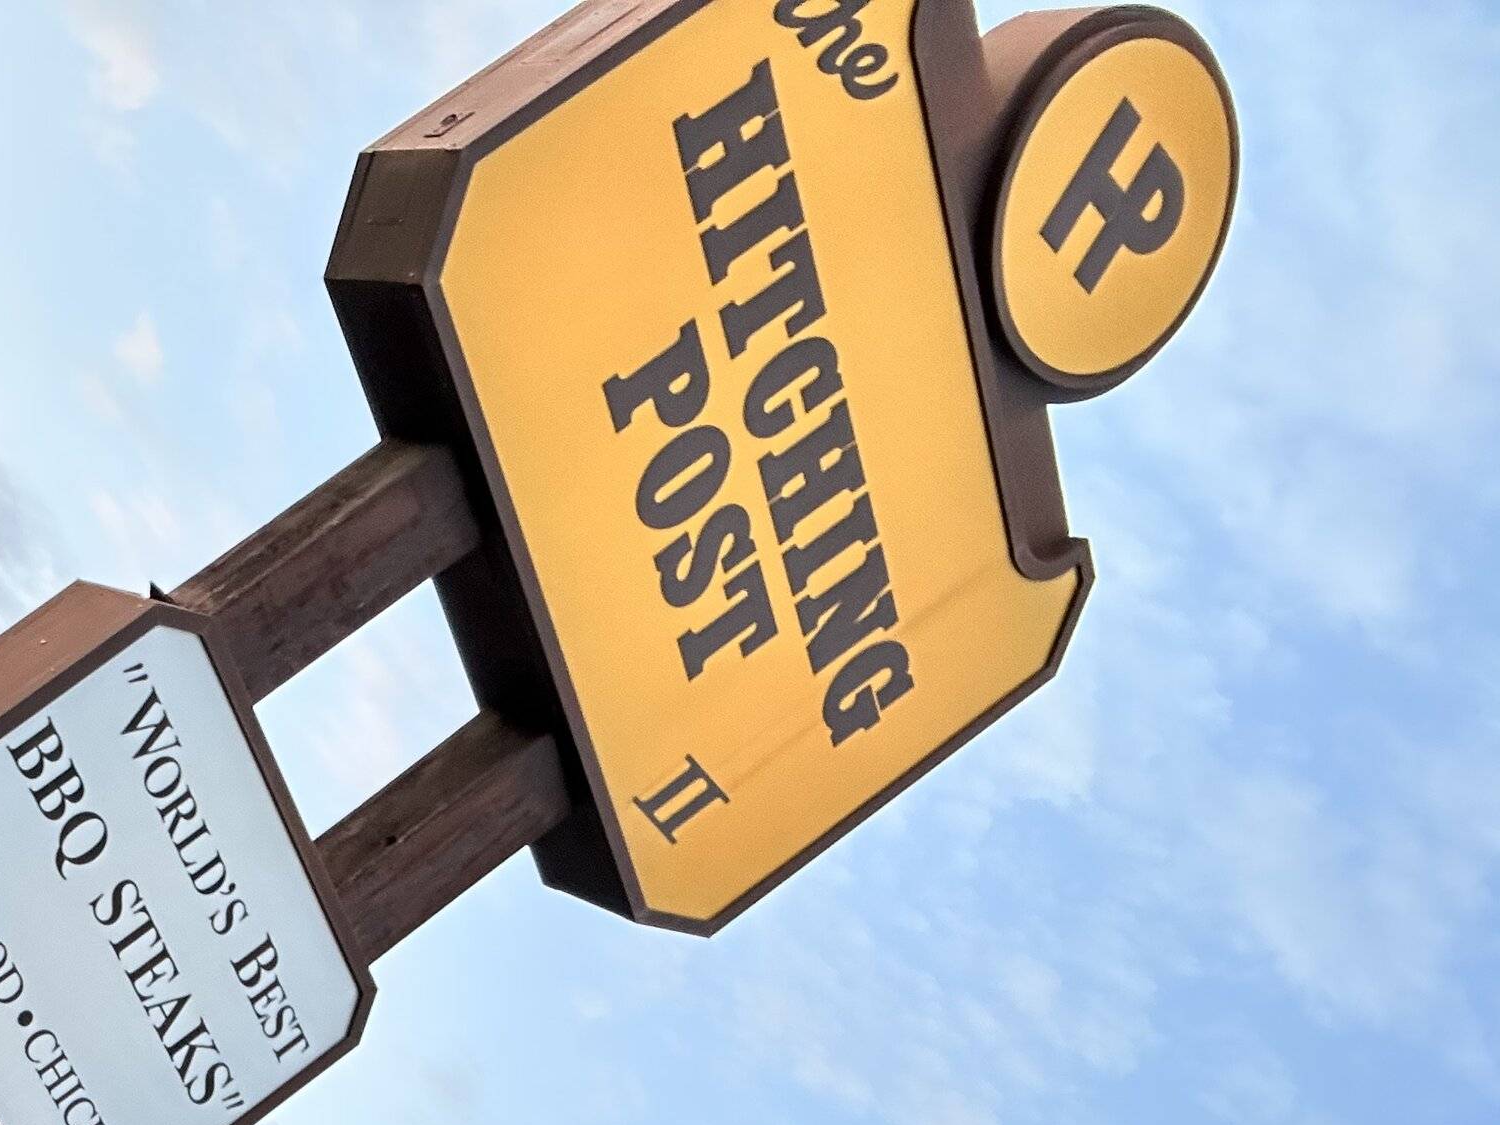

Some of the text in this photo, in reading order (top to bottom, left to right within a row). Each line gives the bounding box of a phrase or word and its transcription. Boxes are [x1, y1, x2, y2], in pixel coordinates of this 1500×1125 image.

[773, 0, 898, 100] he
[672, 58, 914, 747] HITCHING
[602, 319, 778, 681] POST
[7, 717, 108, 880] BBQ
[633, 754, 730, 844] II
[230, 933, 309, 1062] BEST
